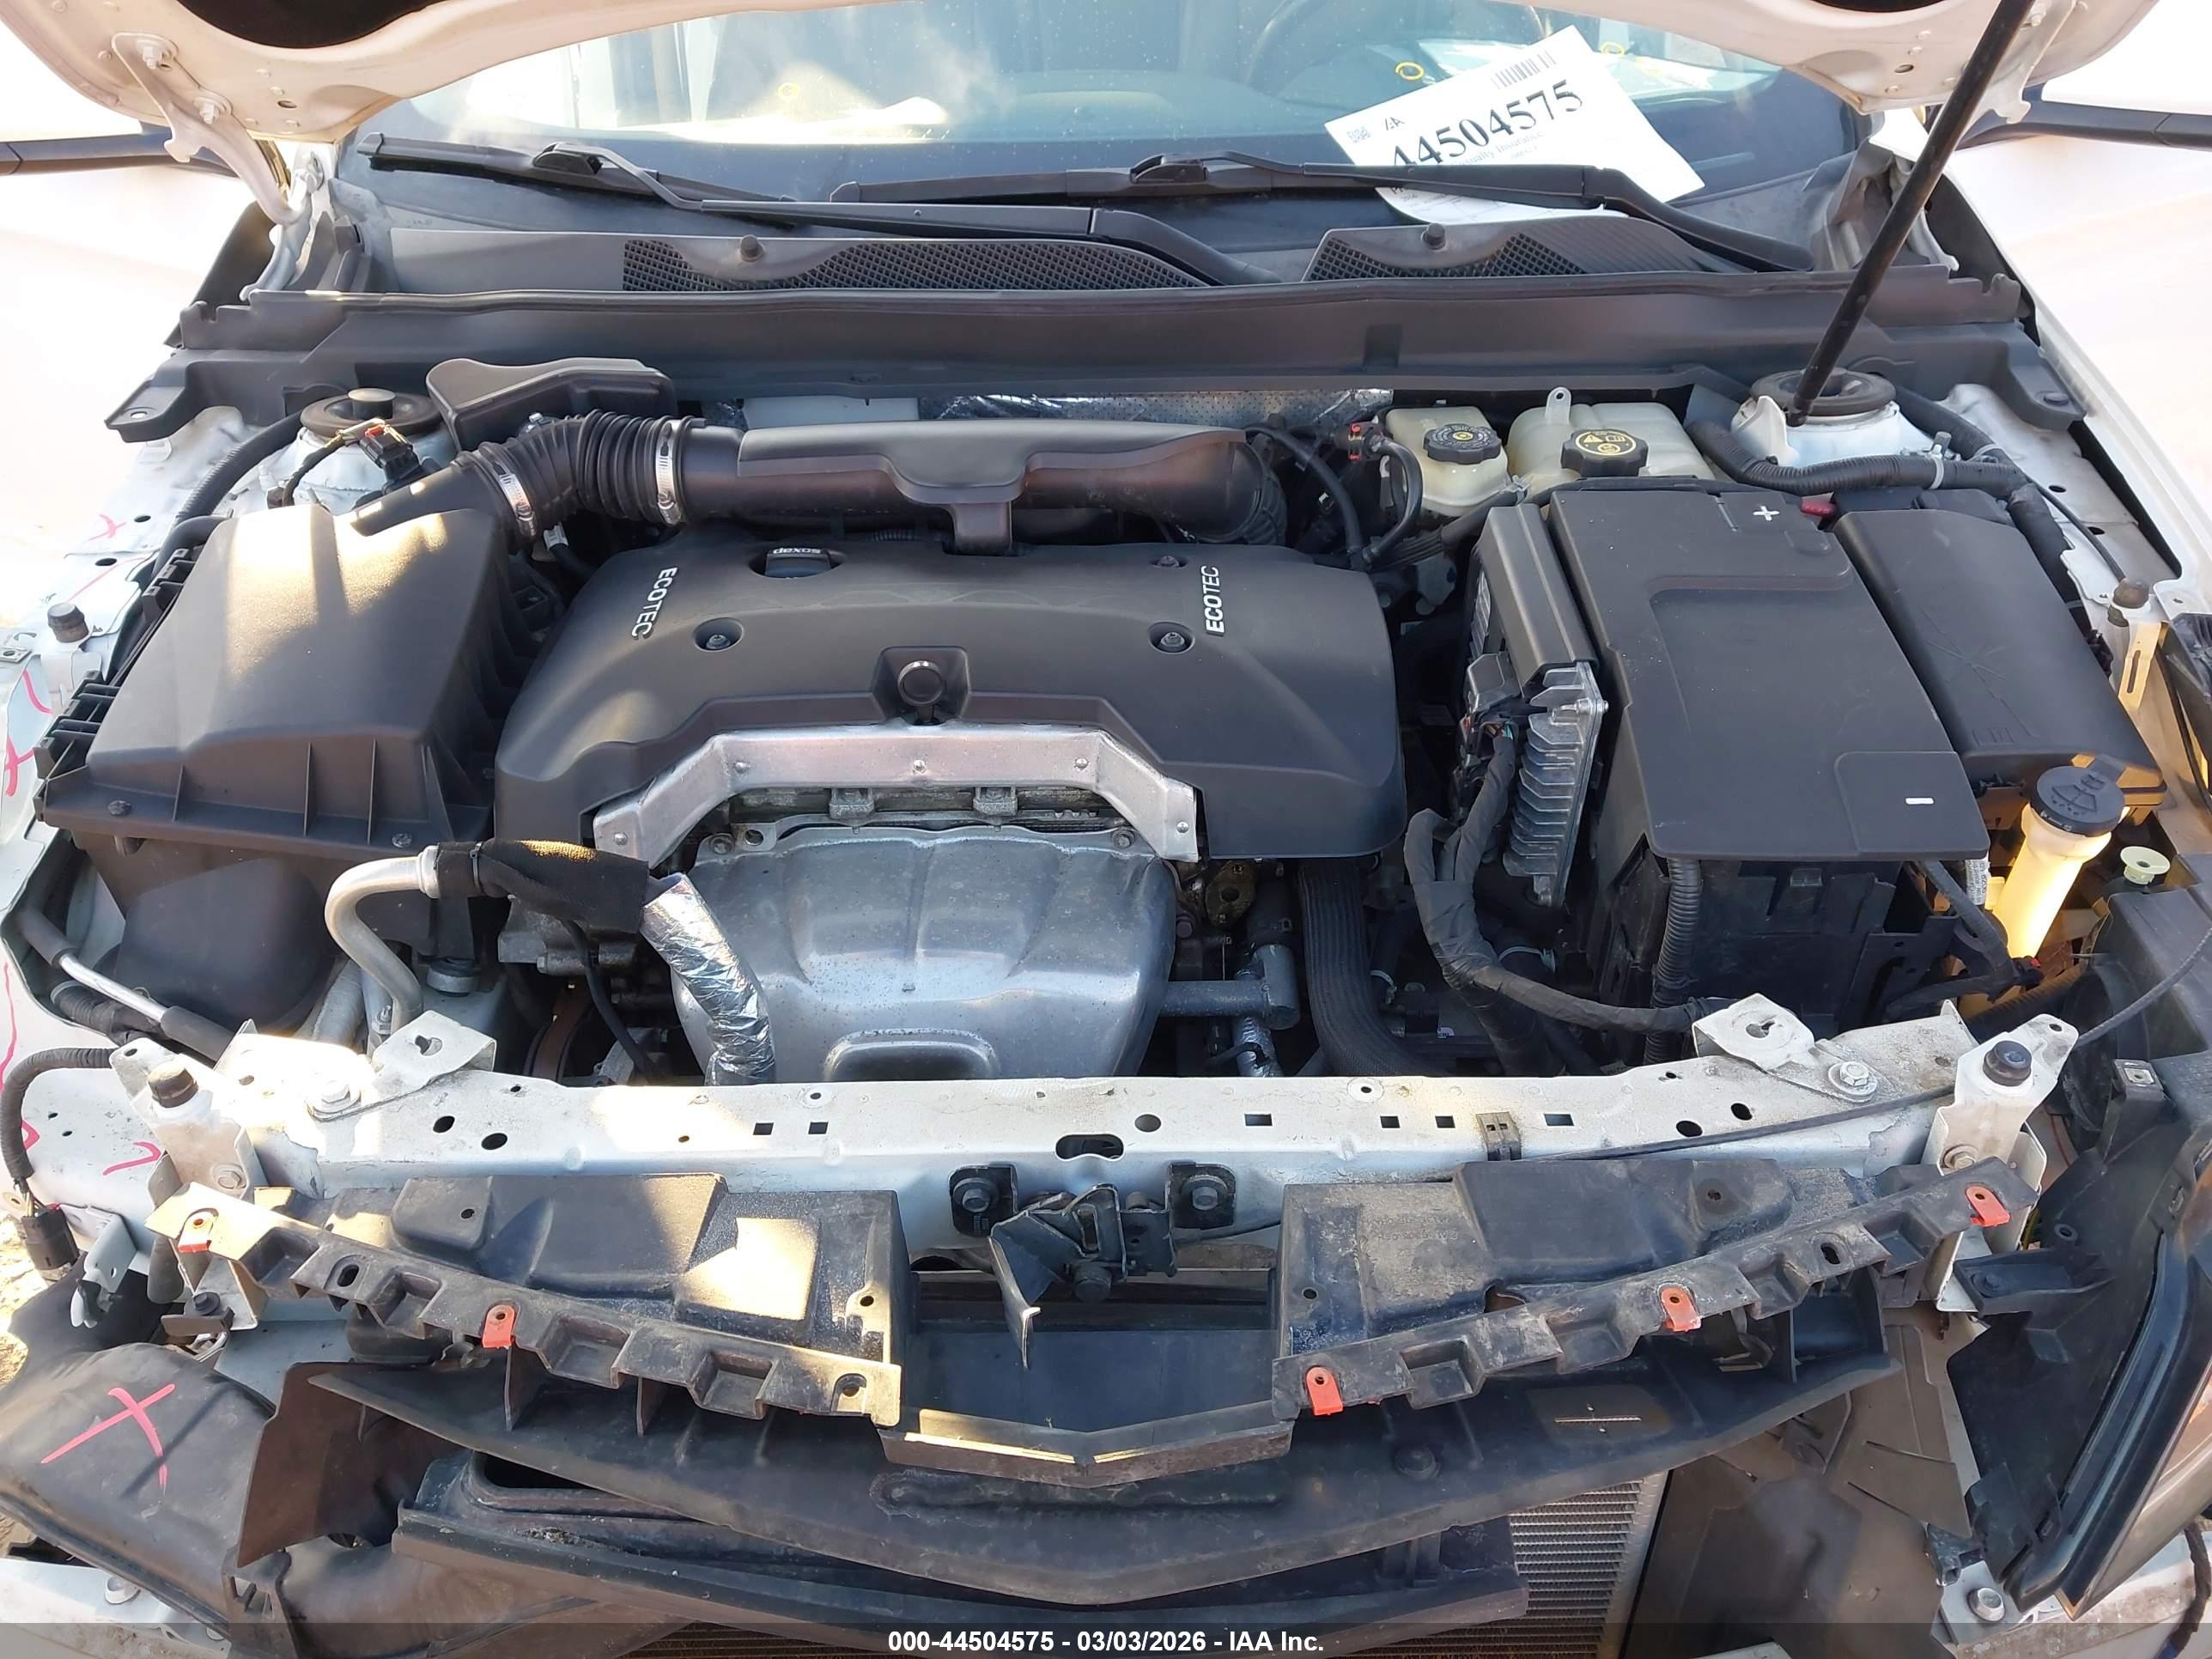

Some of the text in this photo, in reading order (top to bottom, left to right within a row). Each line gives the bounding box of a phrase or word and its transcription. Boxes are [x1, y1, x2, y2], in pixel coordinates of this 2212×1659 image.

[1395, 79, 1583, 166] 44504575
[631, 567, 678, 638] ECOTEC
[1200, 565, 1225, 633] ECOTEC
